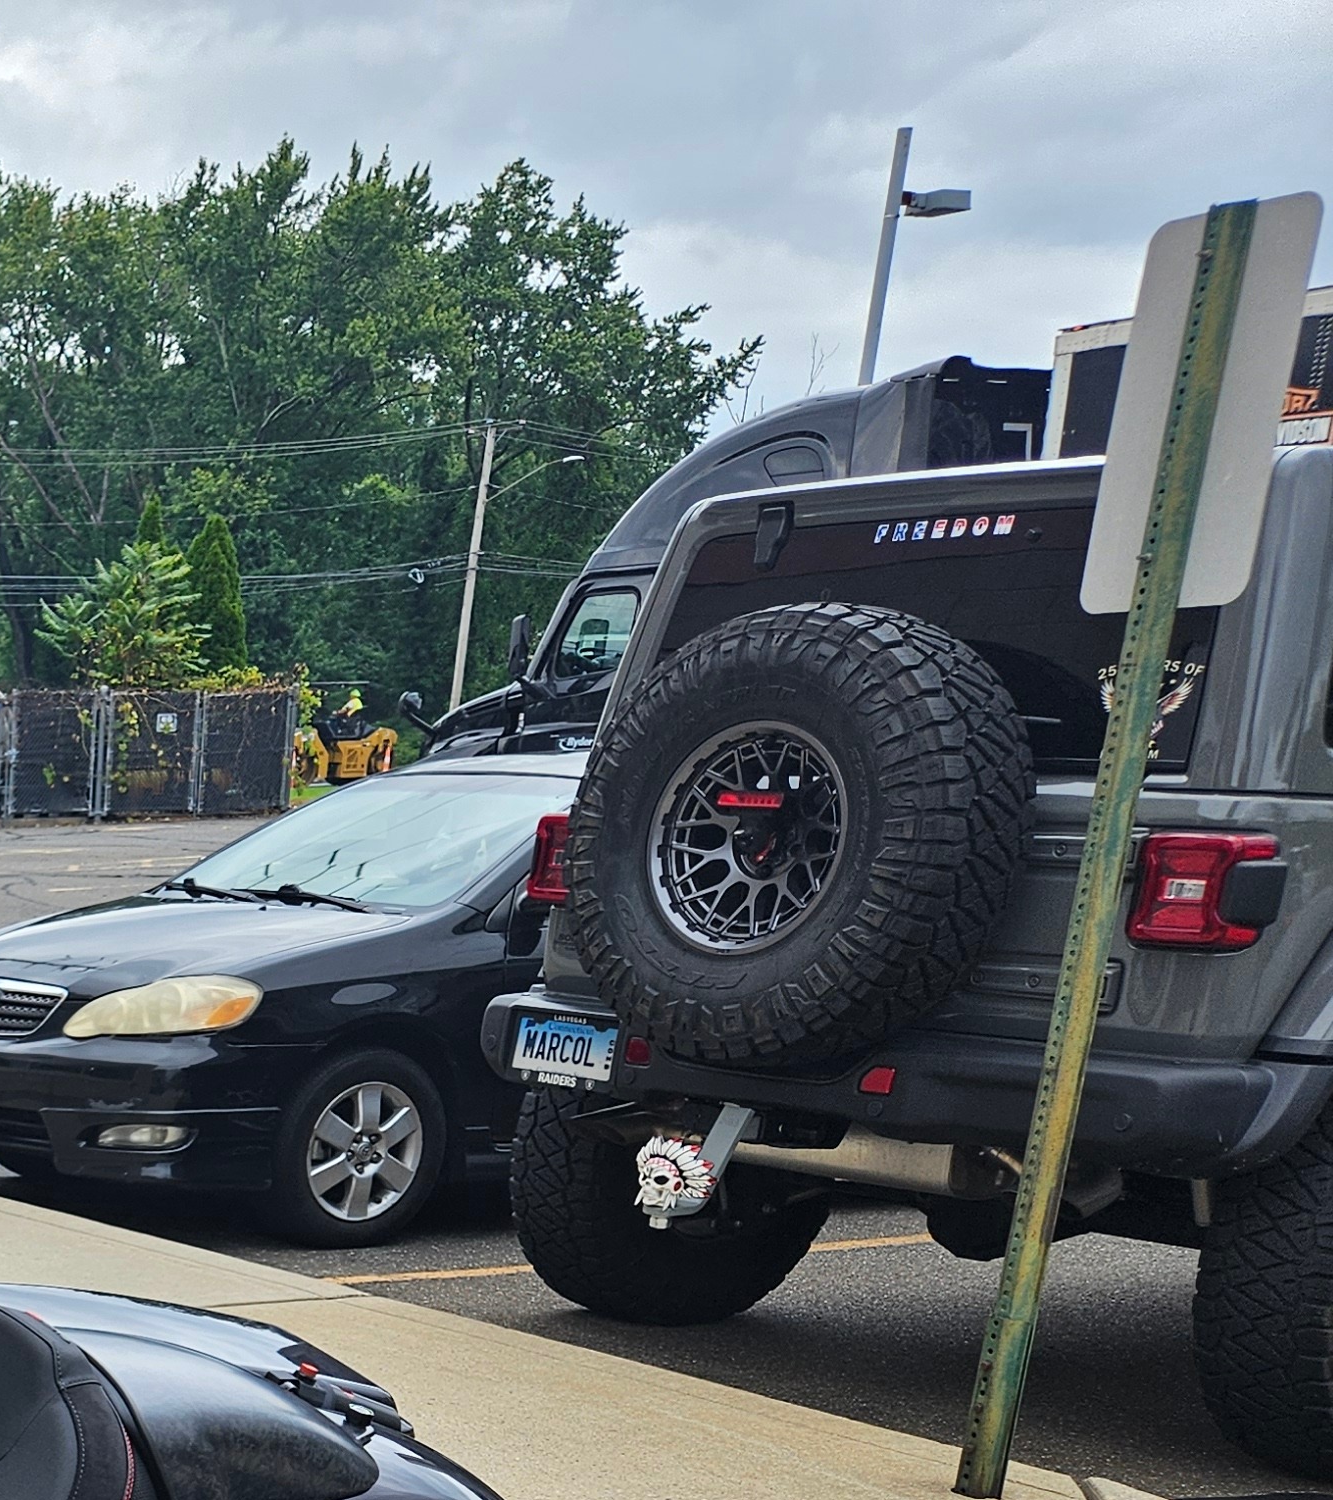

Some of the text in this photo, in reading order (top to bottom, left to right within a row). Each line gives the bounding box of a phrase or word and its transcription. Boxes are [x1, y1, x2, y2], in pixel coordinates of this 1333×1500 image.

[874, 515, 1015, 543] FREEDOM
[1184, 663, 1205, 677] OF
[522, 1029, 595, 1067] MARCOL
[537, 1071, 578, 1088] RAIDERS
